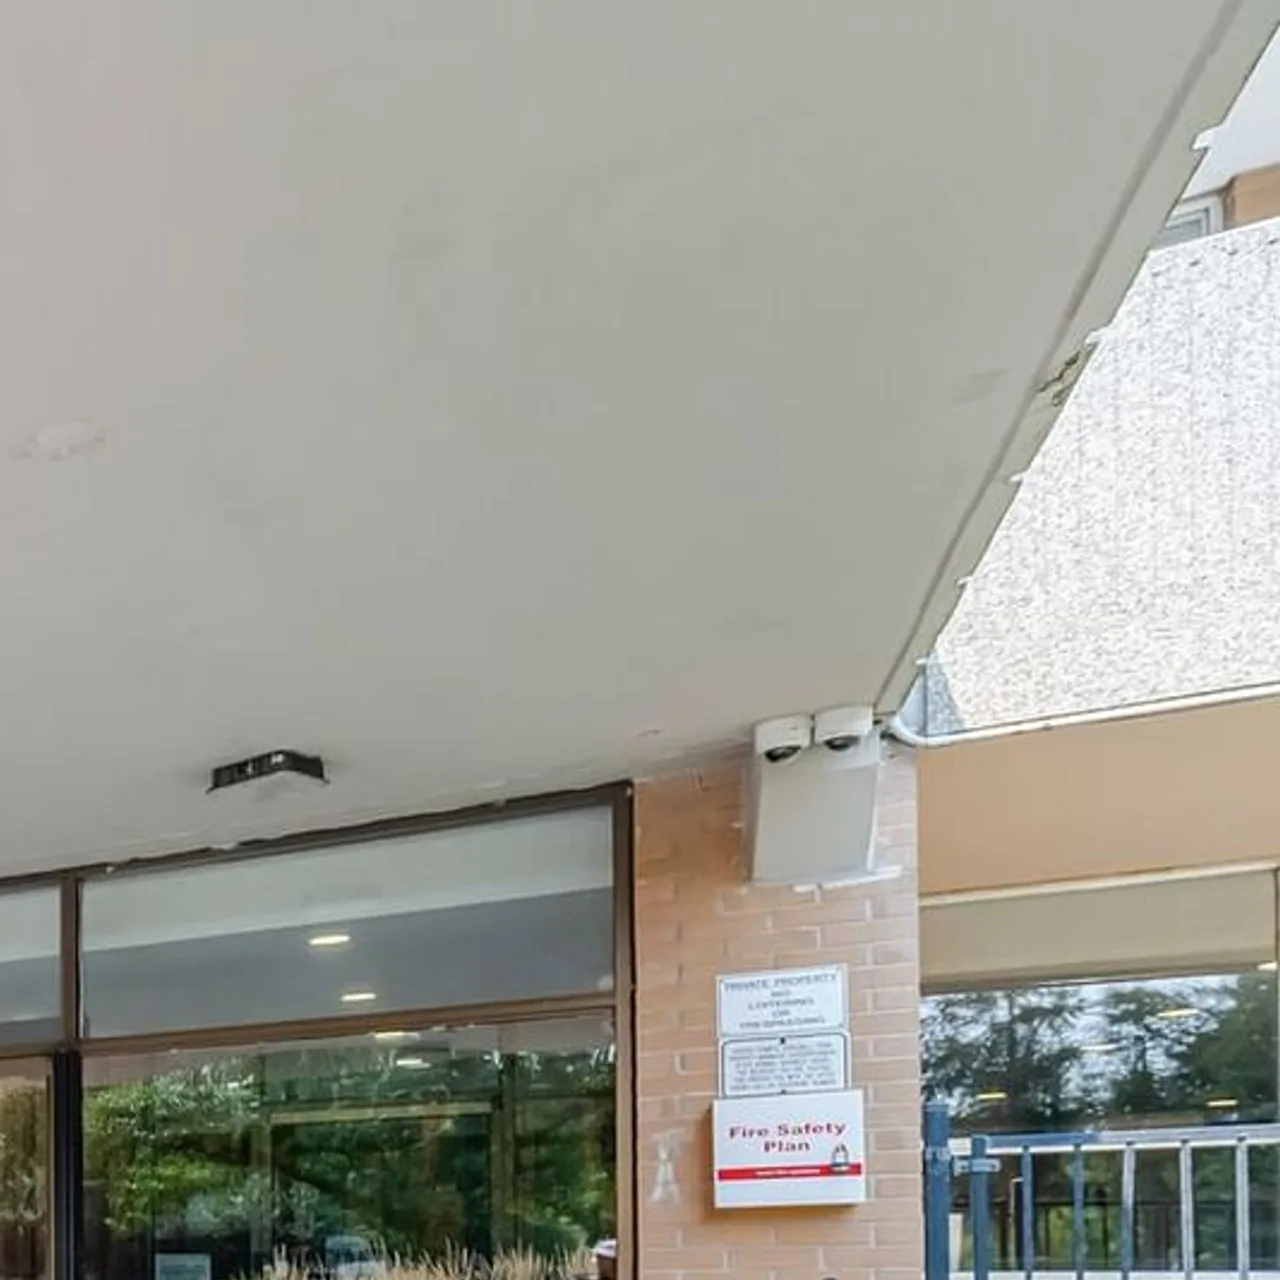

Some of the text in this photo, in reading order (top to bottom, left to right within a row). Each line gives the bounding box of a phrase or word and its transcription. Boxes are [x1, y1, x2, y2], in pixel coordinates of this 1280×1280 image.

[774, 974, 836, 988] PROPERTY
[729, 1123, 846, 1139] Fire Safety
[764, 1140, 811, 1153] Plan
